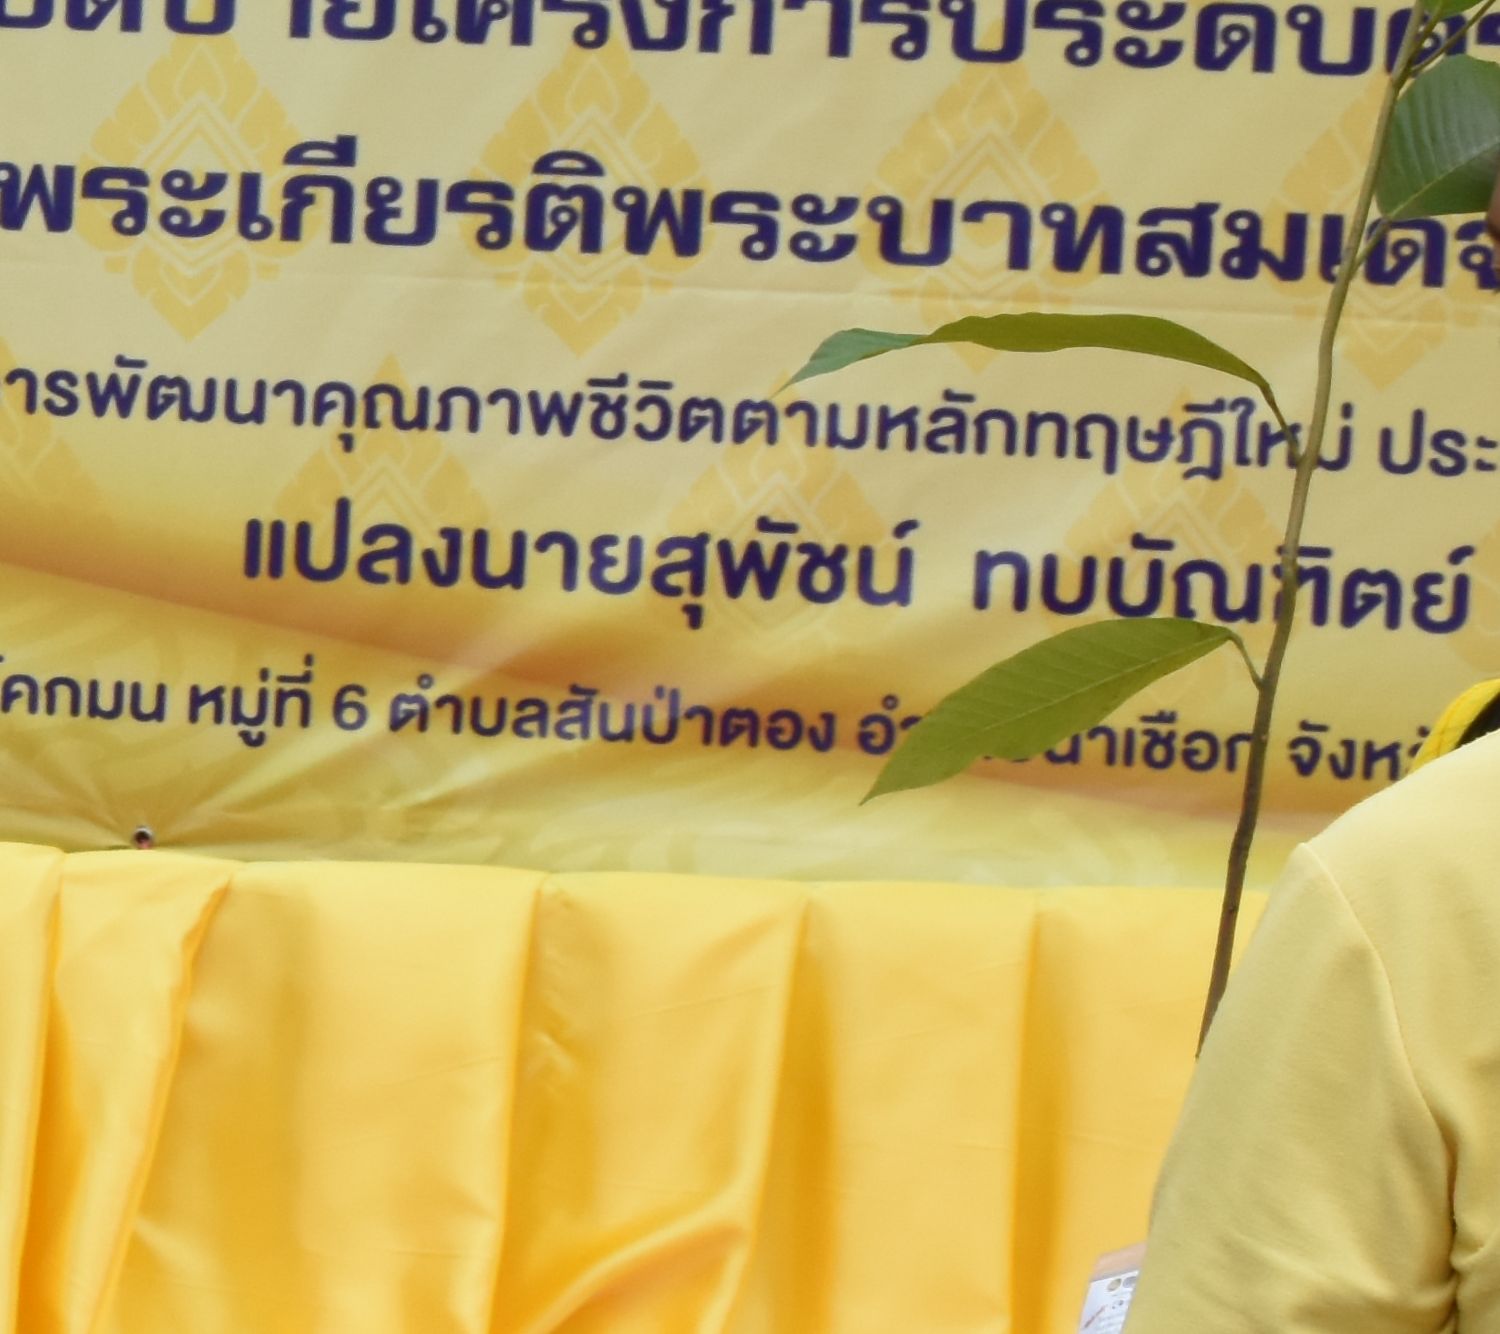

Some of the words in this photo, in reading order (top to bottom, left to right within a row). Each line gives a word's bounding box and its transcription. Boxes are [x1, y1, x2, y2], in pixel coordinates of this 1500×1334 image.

[243, 496, 921, 629] แปลงนายสุพัชน์
[187, 654, 315, 749] หมู่ที่
[332, 684, 367, 732] 6
[388, 674, 836, 754] ตำบลสันป่าตอง
